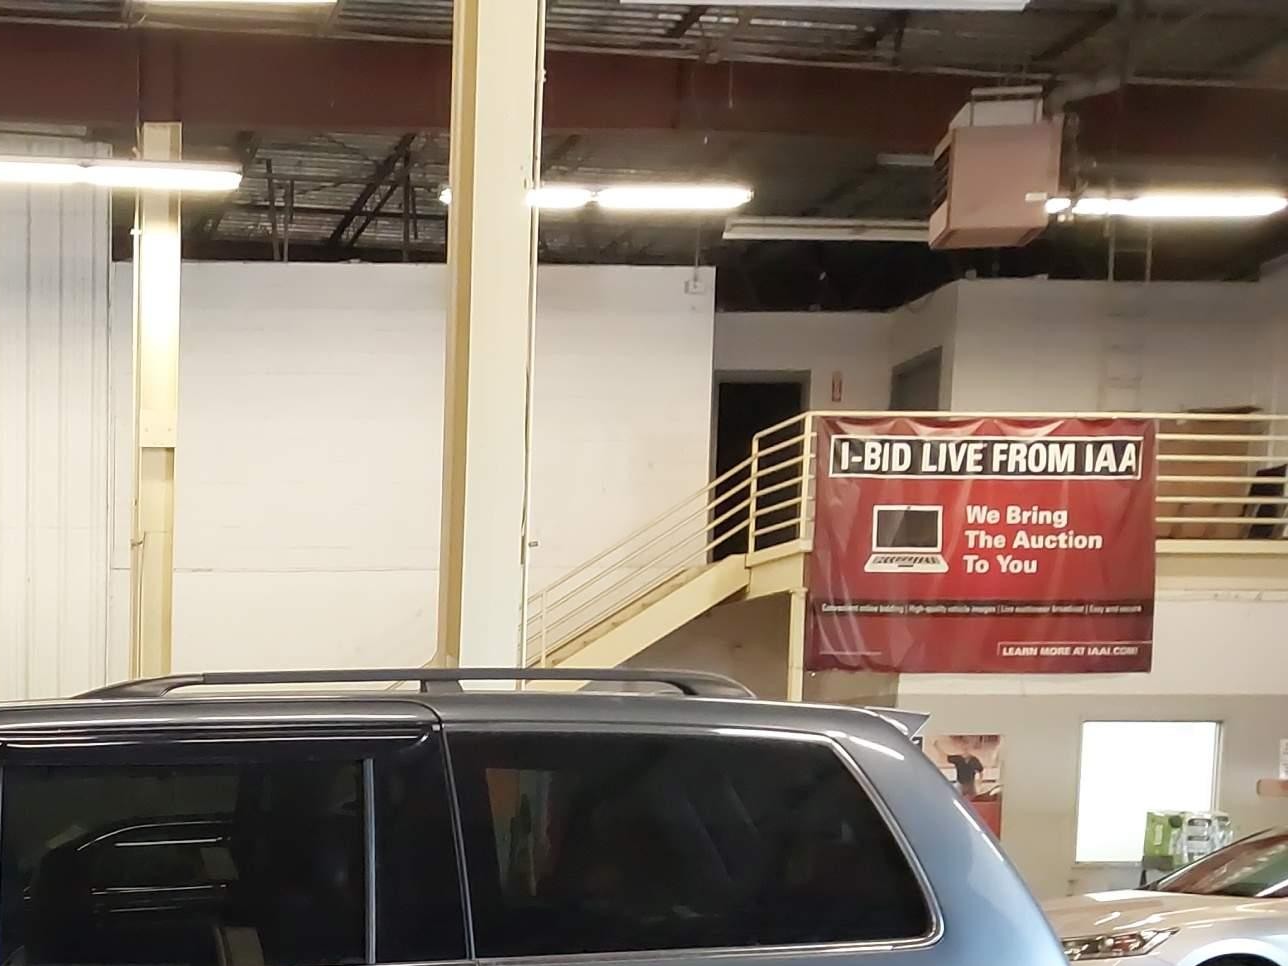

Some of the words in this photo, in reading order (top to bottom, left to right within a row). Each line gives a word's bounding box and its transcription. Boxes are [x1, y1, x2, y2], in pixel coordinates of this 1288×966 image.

[840, 441, 912, 470] I-BID
[920, 443, 984, 472] LIVE
[992, 443, 1075, 473] FROM
[1084, 443, 1137, 473] IAA
[966, 505, 1001, 524] We
[1006, 505, 1068, 528] Bring
[964, 530, 1006, 549] The
[1012, 530, 1103, 549] Auction
[963, 554, 990, 573] To
[996, 554, 1038, 573] You
[1002, 646, 1038, 656] LEARN
[1040, 646, 1071, 656] MORE
[1072, 646, 1086, 656] AT
